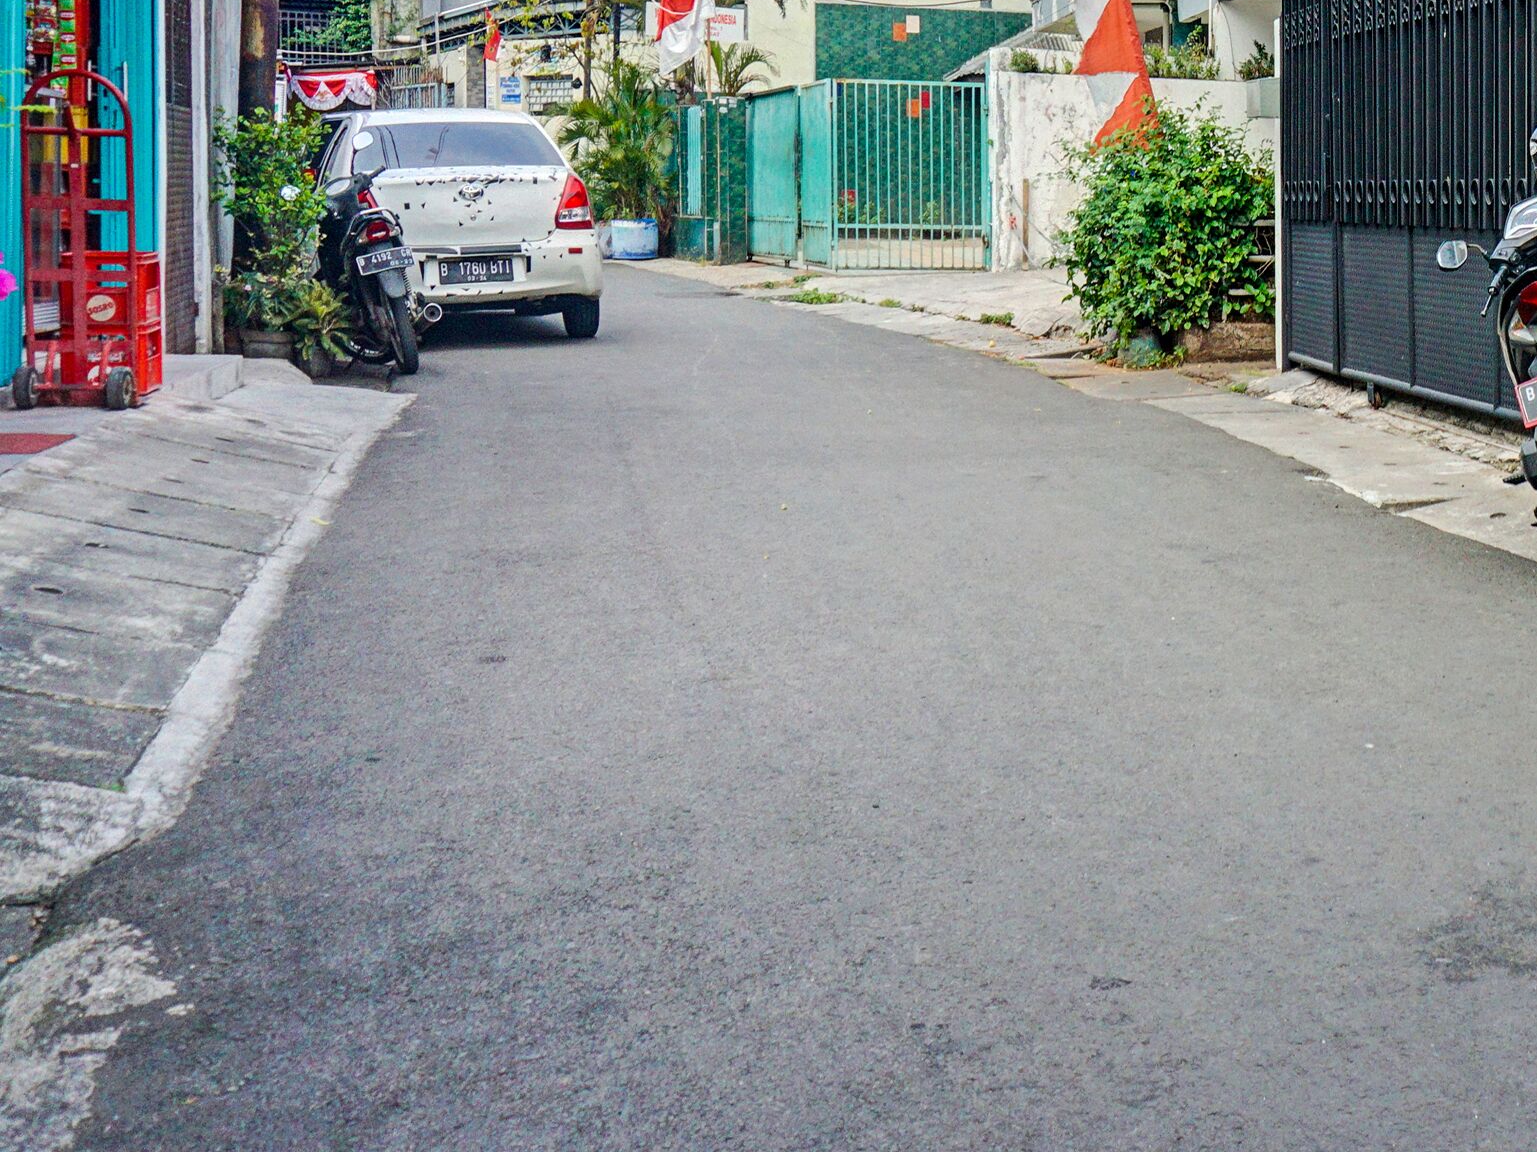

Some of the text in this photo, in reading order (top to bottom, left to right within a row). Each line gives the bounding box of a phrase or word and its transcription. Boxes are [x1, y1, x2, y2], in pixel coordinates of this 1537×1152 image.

[371, 251, 393, 264] 4192
[440, 262, 448, 277] B
[87, 301, 114, 315] SOSRO
[1525, 386, 1536, 402] B
